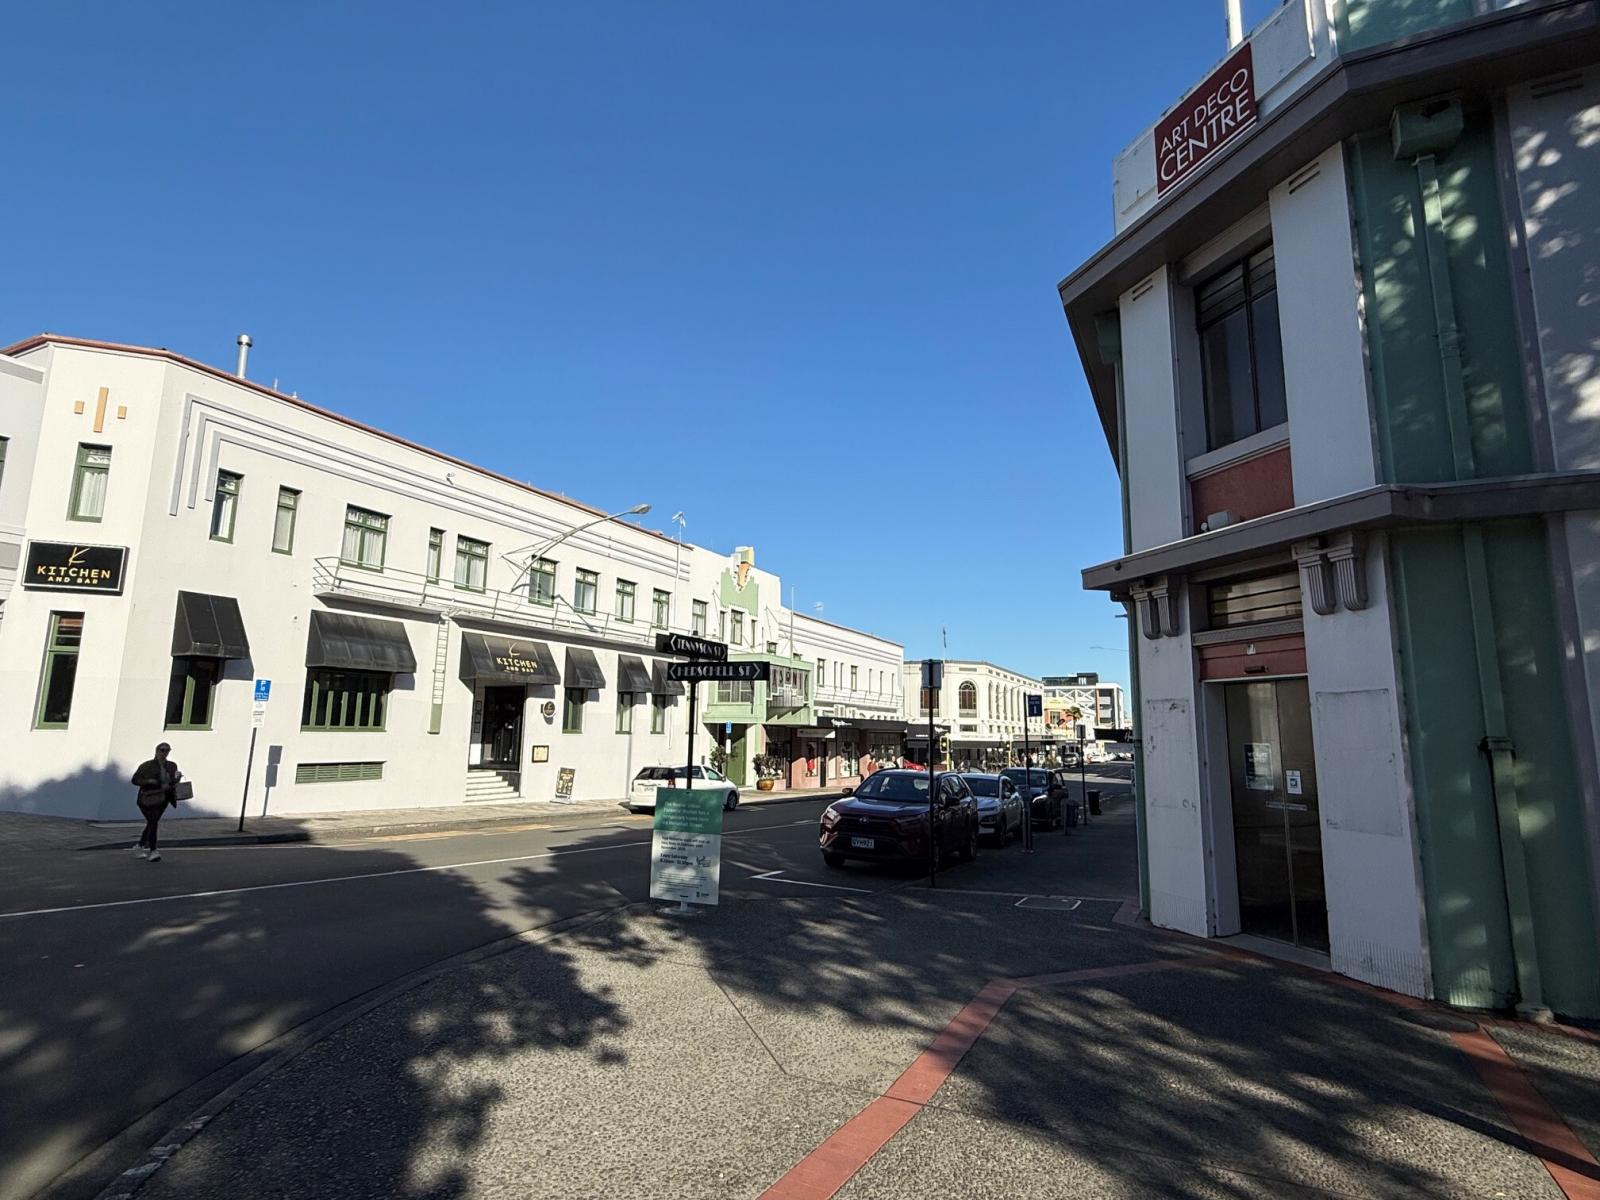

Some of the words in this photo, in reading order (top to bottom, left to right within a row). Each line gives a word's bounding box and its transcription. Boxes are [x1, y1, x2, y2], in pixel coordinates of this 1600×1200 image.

[1160, 116, 1190, 159] ART
[1194, 68, 1248, 128] DECO
[1160, 89, 1251, 181] CENTRE
[37, 565, 111, 579] KITCHEN
[76, 577, 99, 585] BAR
[713, 645, 722, 657] ST
[496, 657, 538, 669] KITCHEN
[677, 665, 734, 677] HERSCHELL
[738, 665, 751, 677] ST
